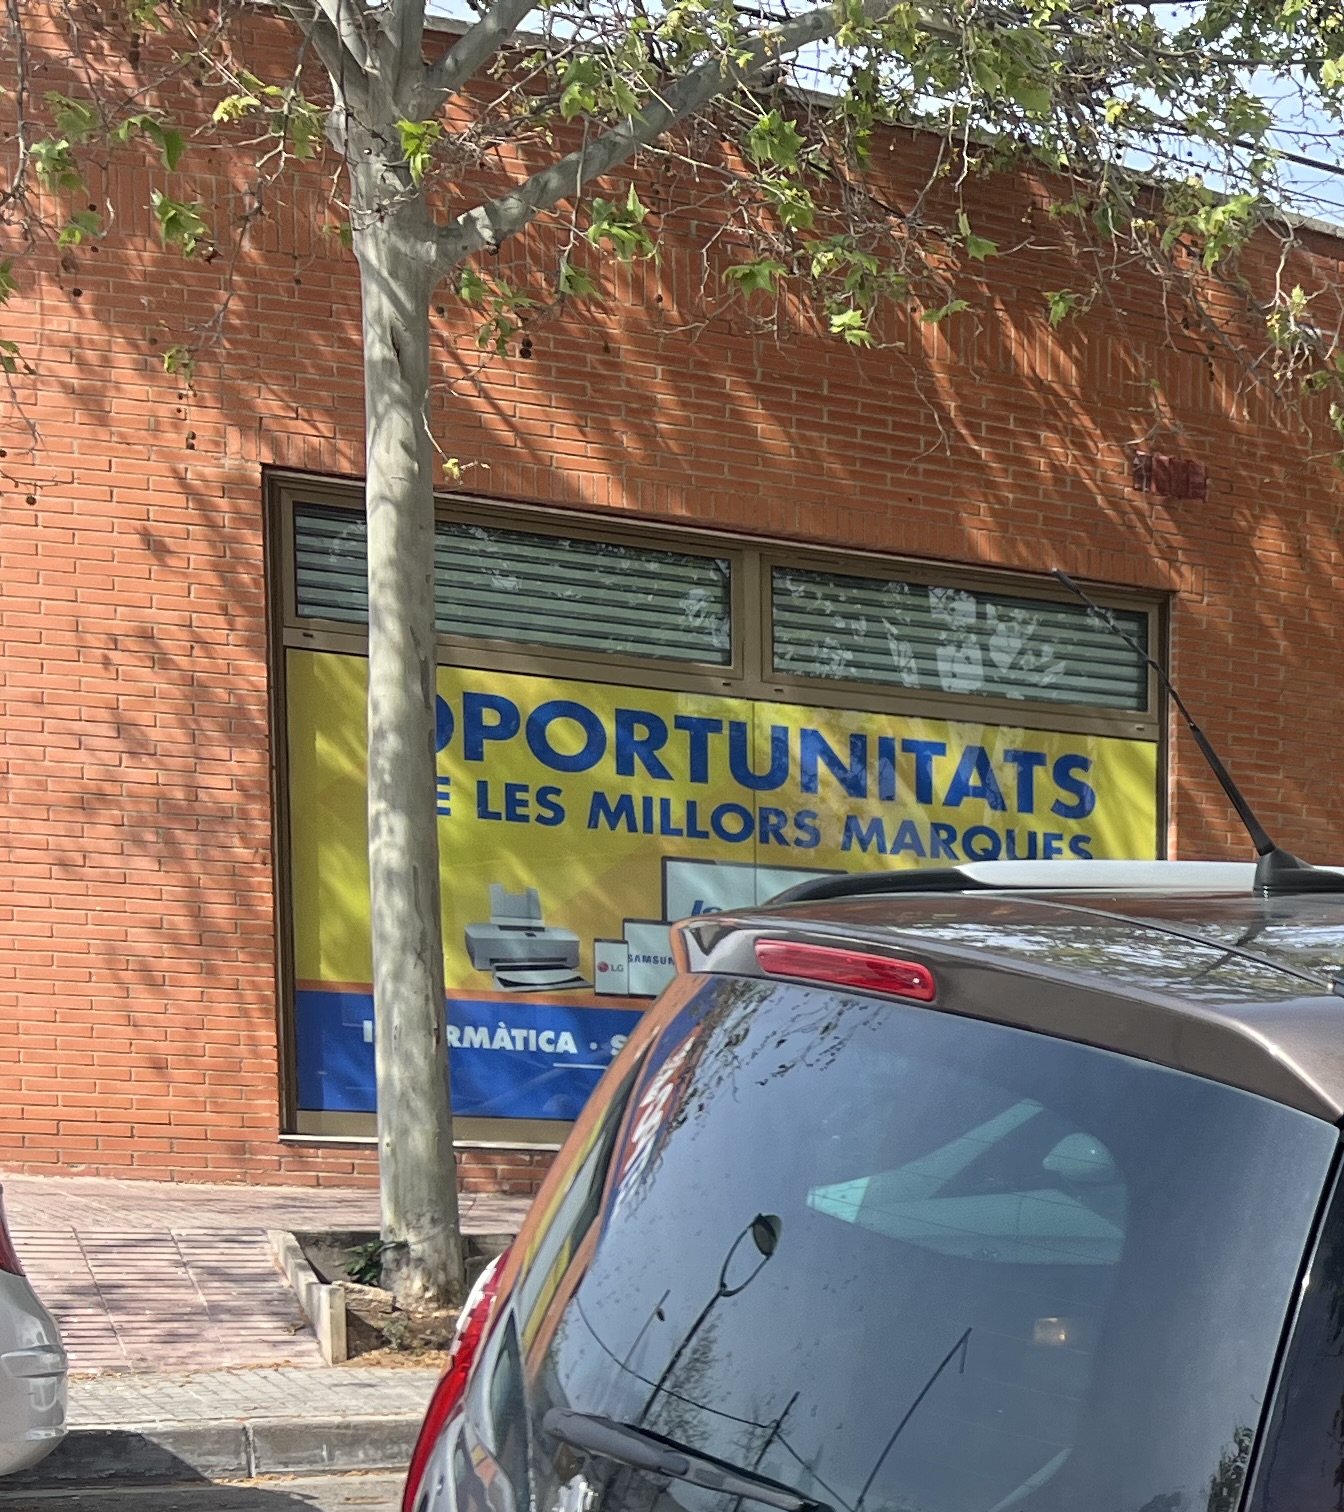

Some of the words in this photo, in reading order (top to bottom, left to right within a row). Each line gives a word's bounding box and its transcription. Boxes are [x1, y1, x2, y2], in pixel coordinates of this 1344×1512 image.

[436, 691, 1096, 820] PORTUNITATS
[477, 780, 565, 826] LES
[587, 791, 821, 849] MILLORS
[840, 815, 1093, 862] MARQUES
[610, 964, 624, 972] LG
[628, 954, 674, 965] SAMSUN
